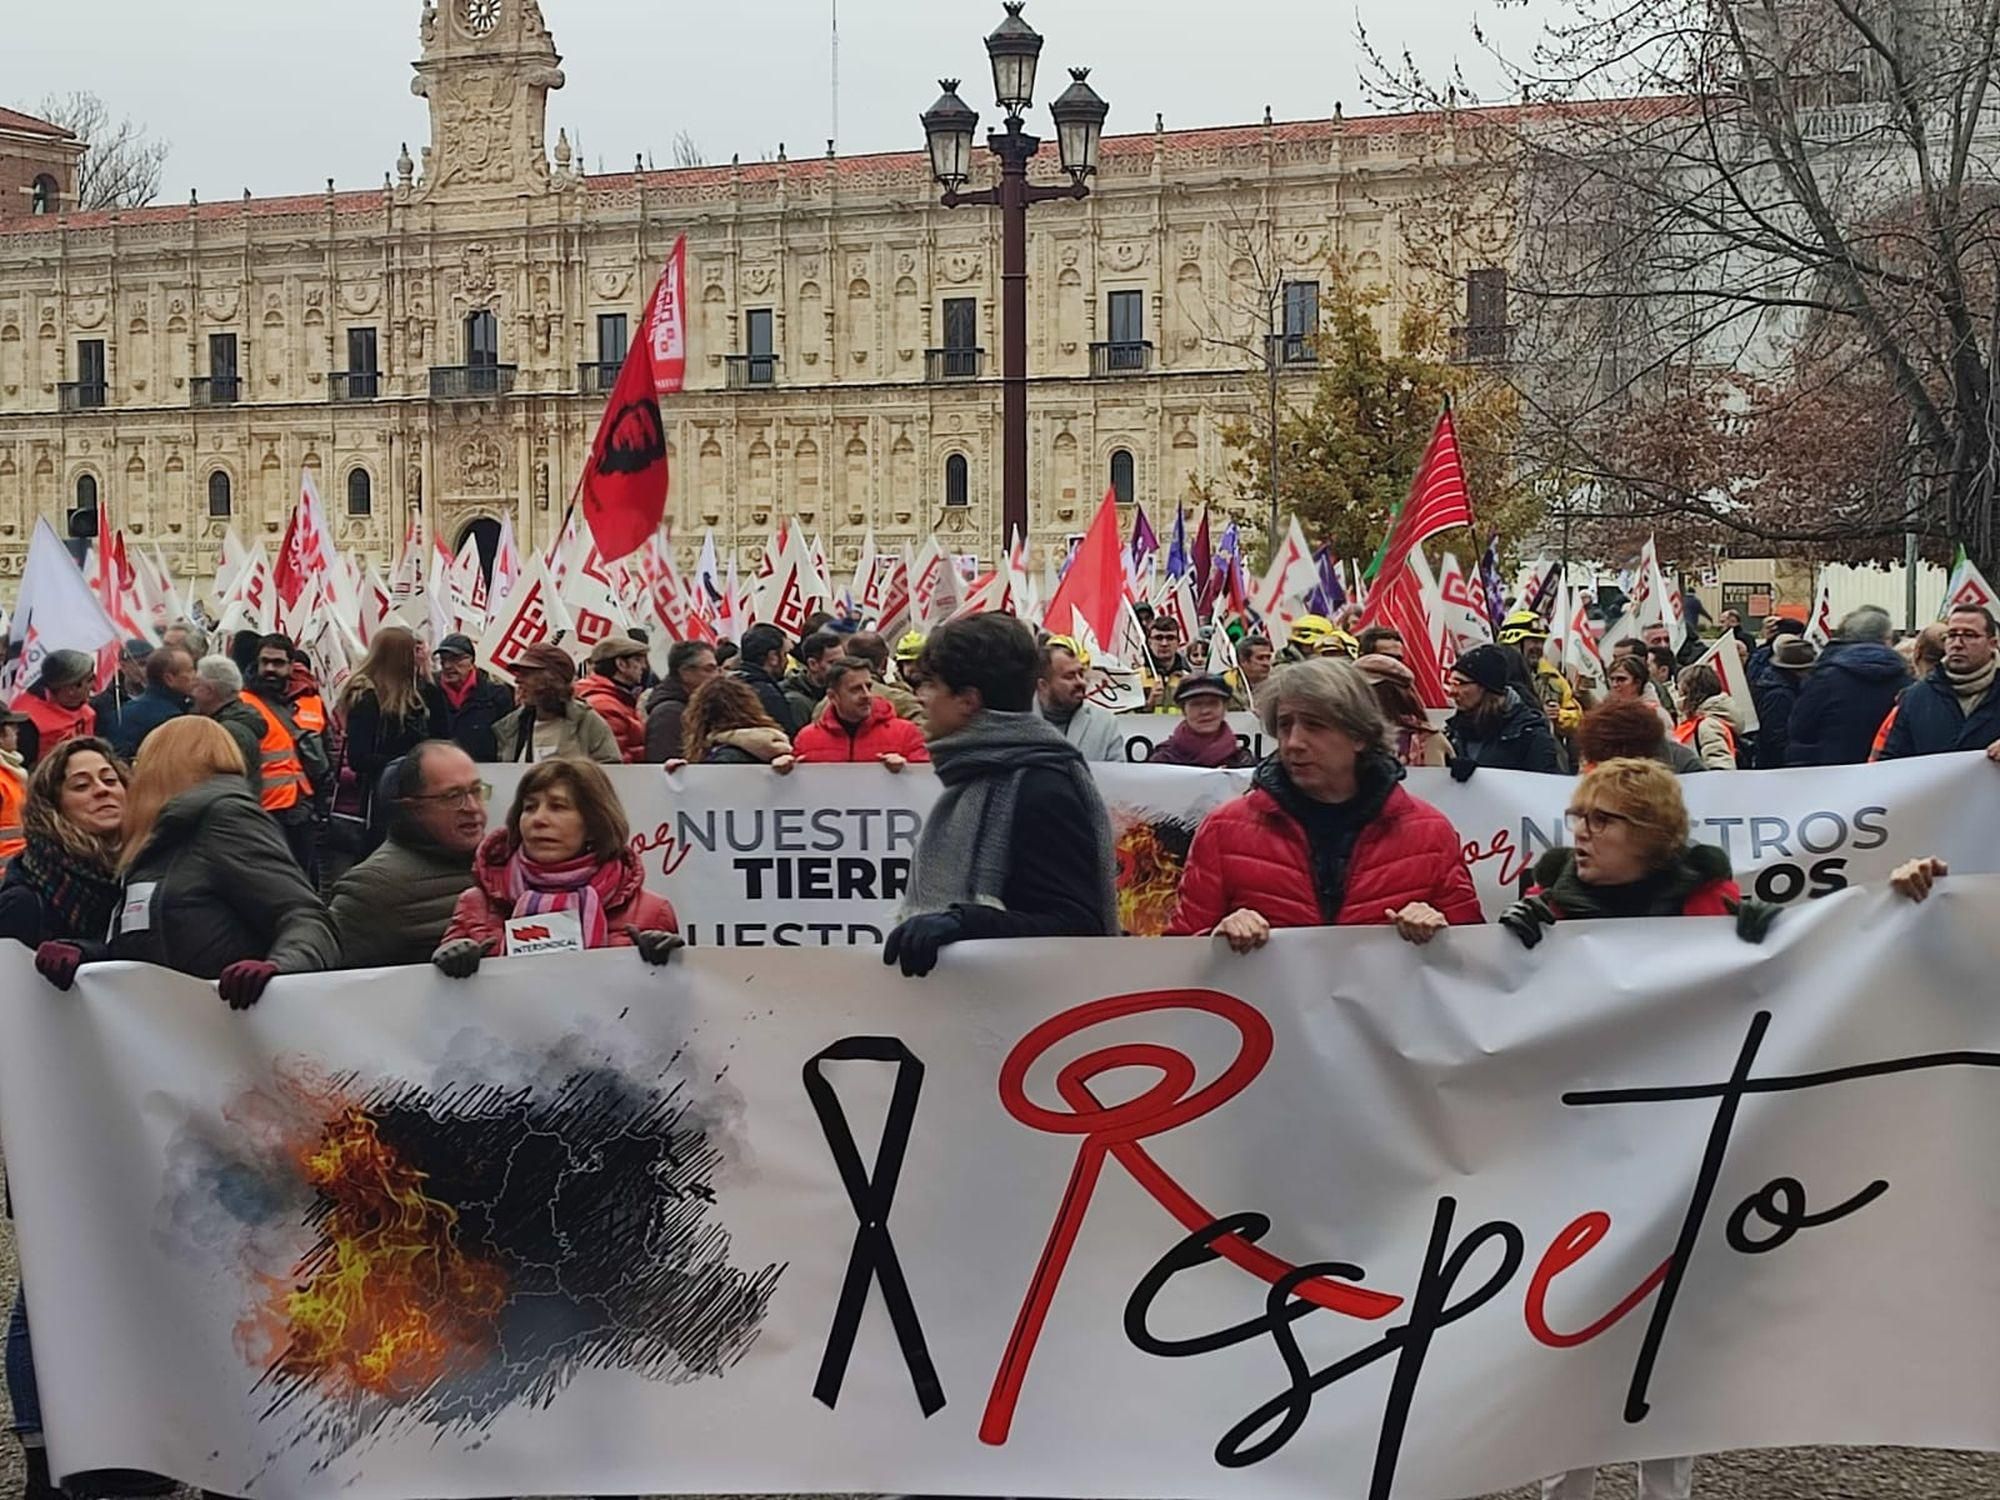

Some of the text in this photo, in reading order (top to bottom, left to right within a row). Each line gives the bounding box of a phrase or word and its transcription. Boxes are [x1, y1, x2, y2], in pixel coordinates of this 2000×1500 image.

[630, 808, 922, 875] or NUESTR
[1461, 829, 1533, 886] or
[733, 857, 912, 900] TIERR
[980, 988, 2000, 1499] Respeto
